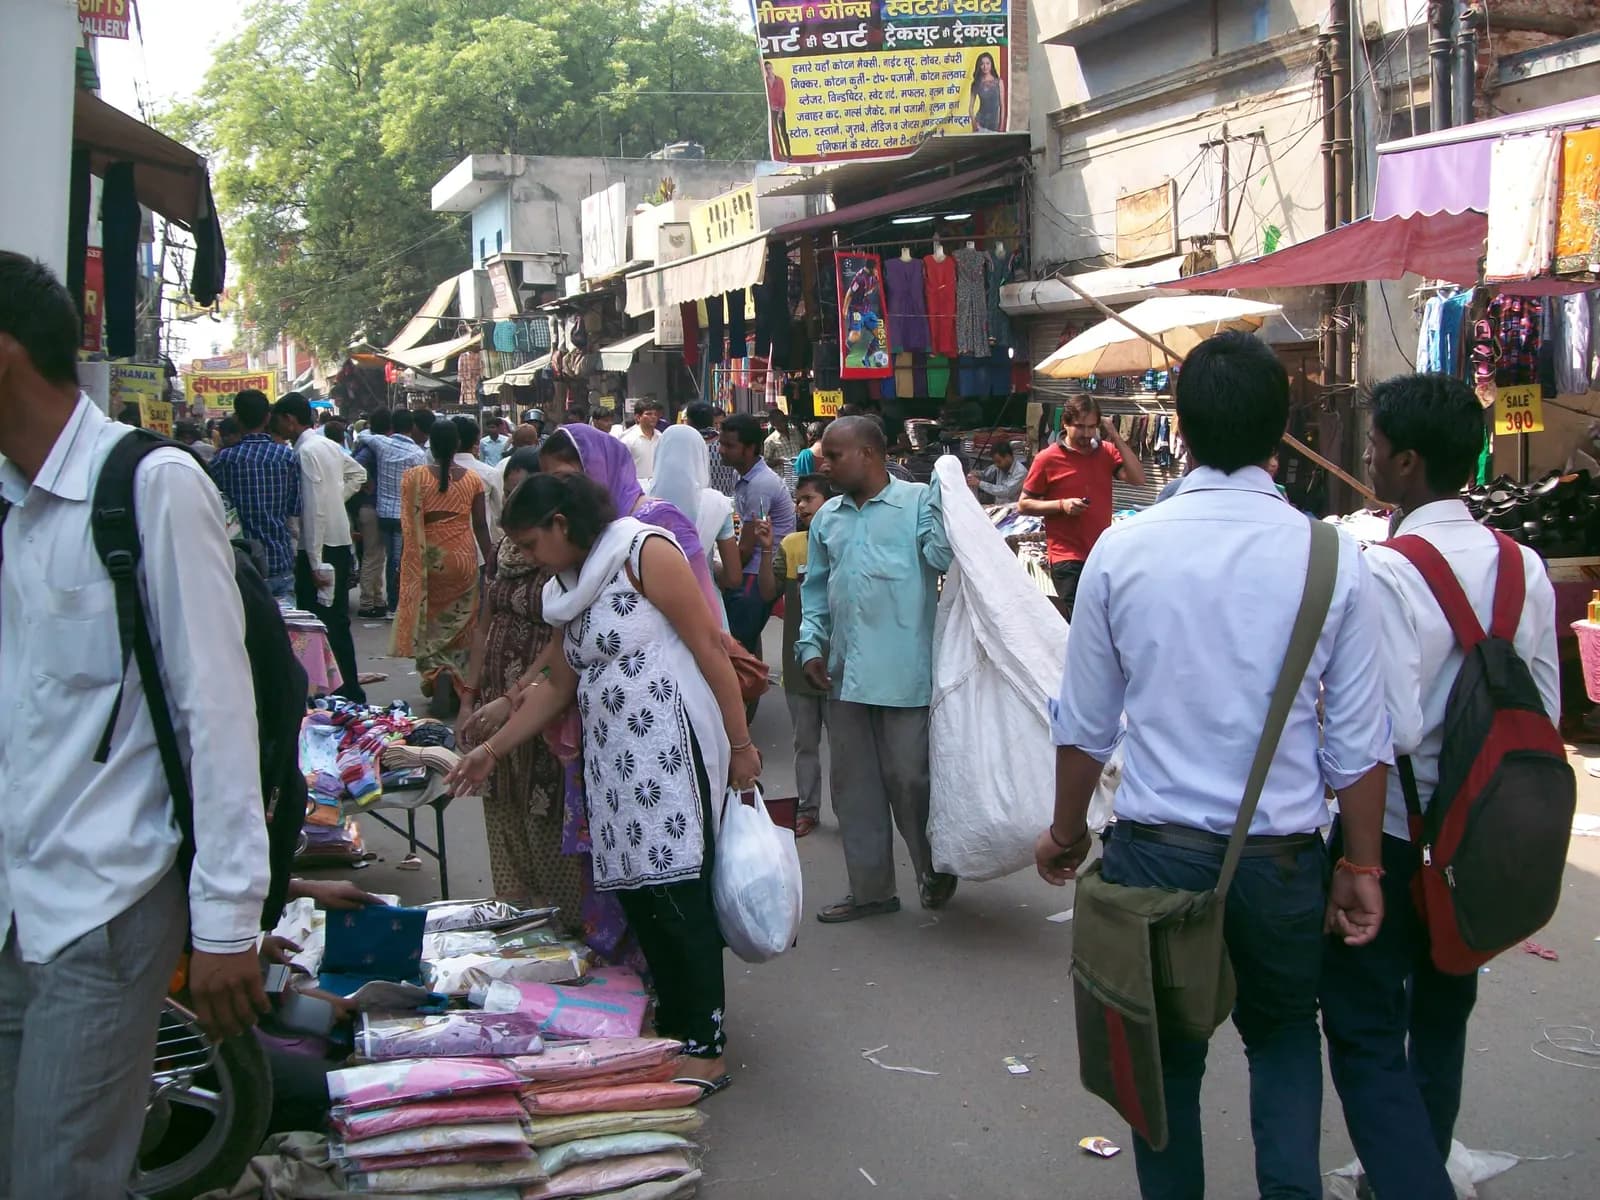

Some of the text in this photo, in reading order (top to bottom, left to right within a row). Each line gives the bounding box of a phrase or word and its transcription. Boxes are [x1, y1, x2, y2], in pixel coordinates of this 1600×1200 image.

[817, 0, 872, 20] जीन्स
[80, 16, 127, 38] ALLERY
[821, 22, 869, 49] शर्ट
[112, 367, 156, 380] HANAK
[821, 395, 836, 403] SALE
[1506, 394, 1529, 408] SALE
[820, 404, 837, 415] 300
